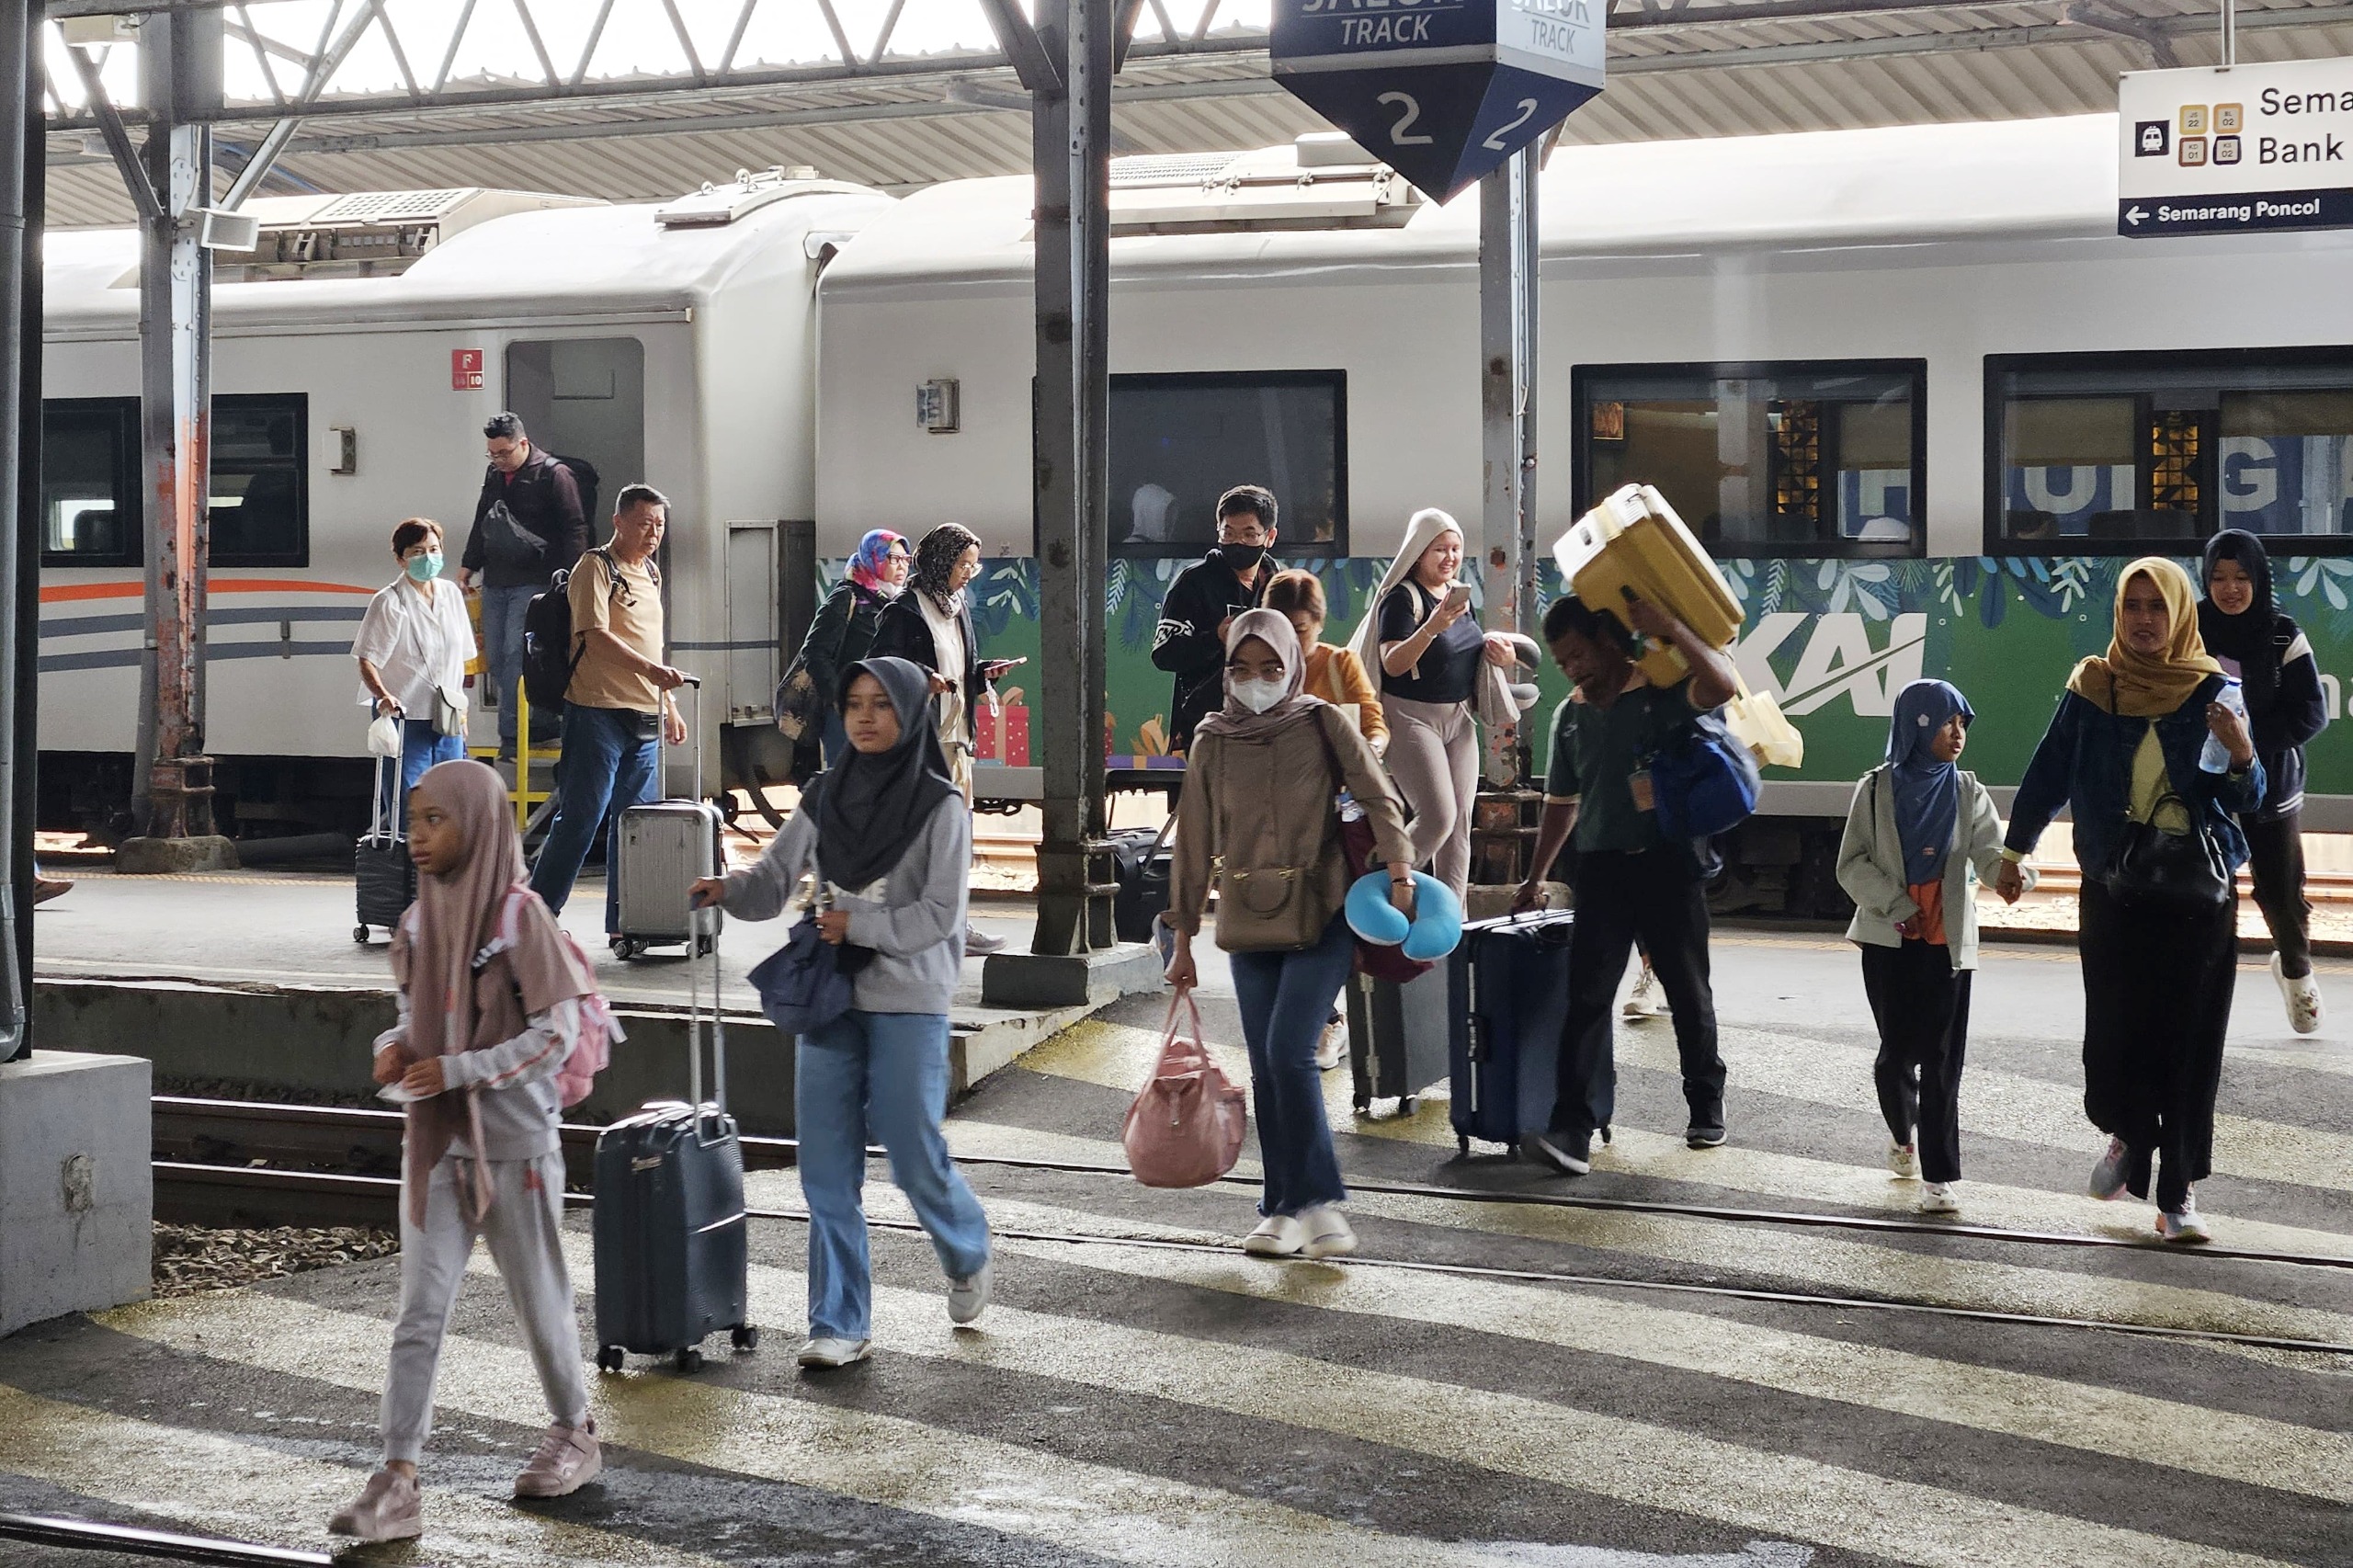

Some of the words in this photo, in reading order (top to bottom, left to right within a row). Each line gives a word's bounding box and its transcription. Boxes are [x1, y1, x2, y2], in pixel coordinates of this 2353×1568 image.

[1341, 14, 1432, 45] TRACK
[1531, 19, 1575, 54] TRACK
[1377, 91, 1434, 145] 2
[2260, 87, 2353, 117] Sema
[1482, 97, 1538, 151] 2
[2222, 150, 2233, 158] 02
[2259, 133, 2345, 165] Bank
[2158, 204, 2251, 222] Semarang
[2256, 199, 2320, 217] Poncol
[1733, 612, 1928, 717] KAI
